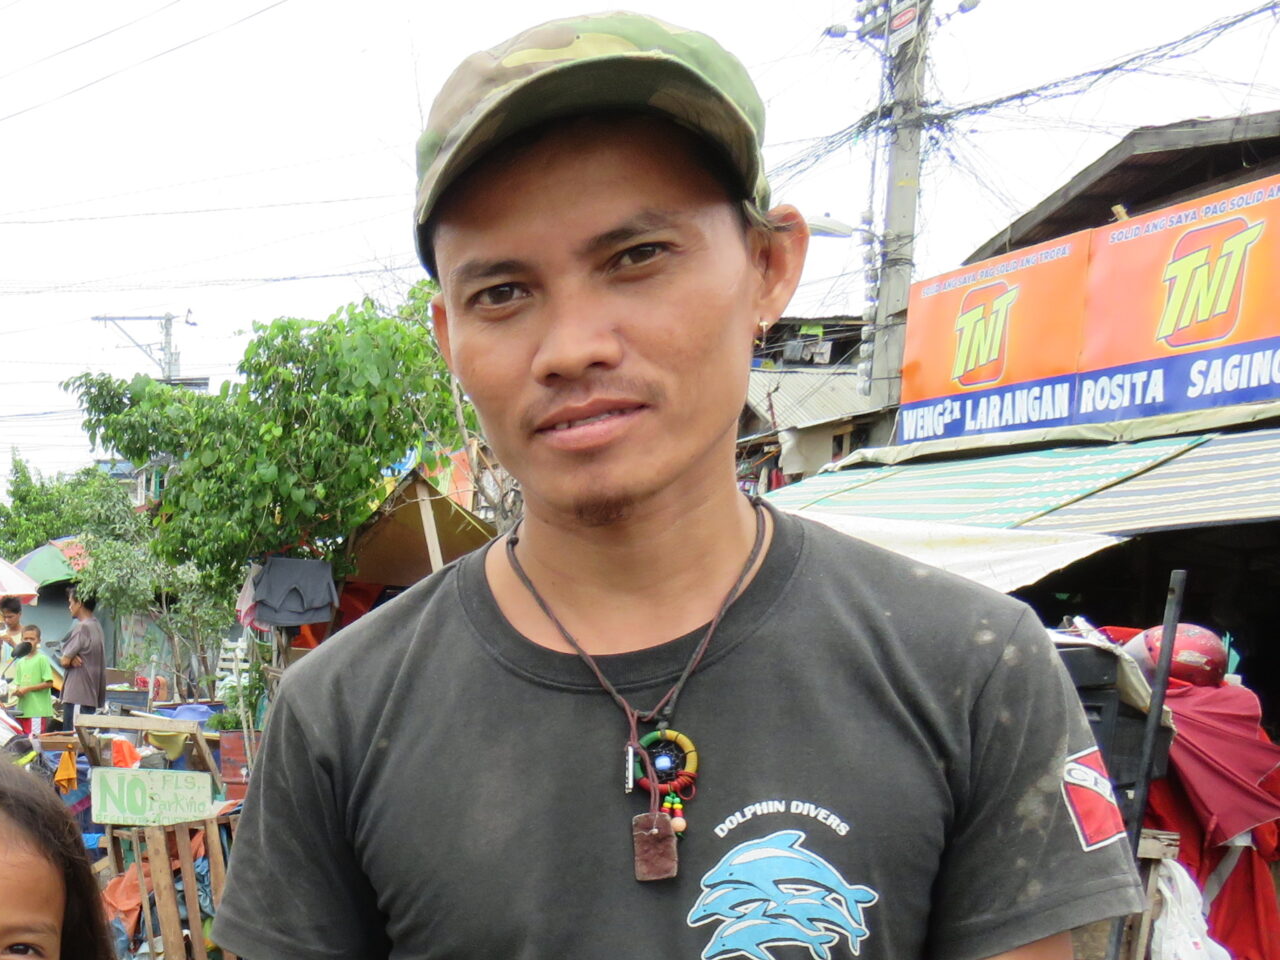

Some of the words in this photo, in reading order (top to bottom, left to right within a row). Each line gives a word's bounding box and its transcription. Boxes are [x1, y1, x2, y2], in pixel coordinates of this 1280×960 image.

[1109, 226, 1141, 242] SOLID
[1144, 218, 1166, 234] ANG
[1168, 210, 1197, 227] SAYA
[1228, 190, 1264, 210] SOLID
[1156, 220, 1264, 341] TNT
[952, 285, 1020, 381] TNT
[965, 383, 1070, 431] LARANGAN
[1079, 369, 1164, 414] ROSITA
[99, 773, 147, 816] NO
[713, 800, 786, 839] DOLPHIN
[790, 800, 850, 837] DIVERS
